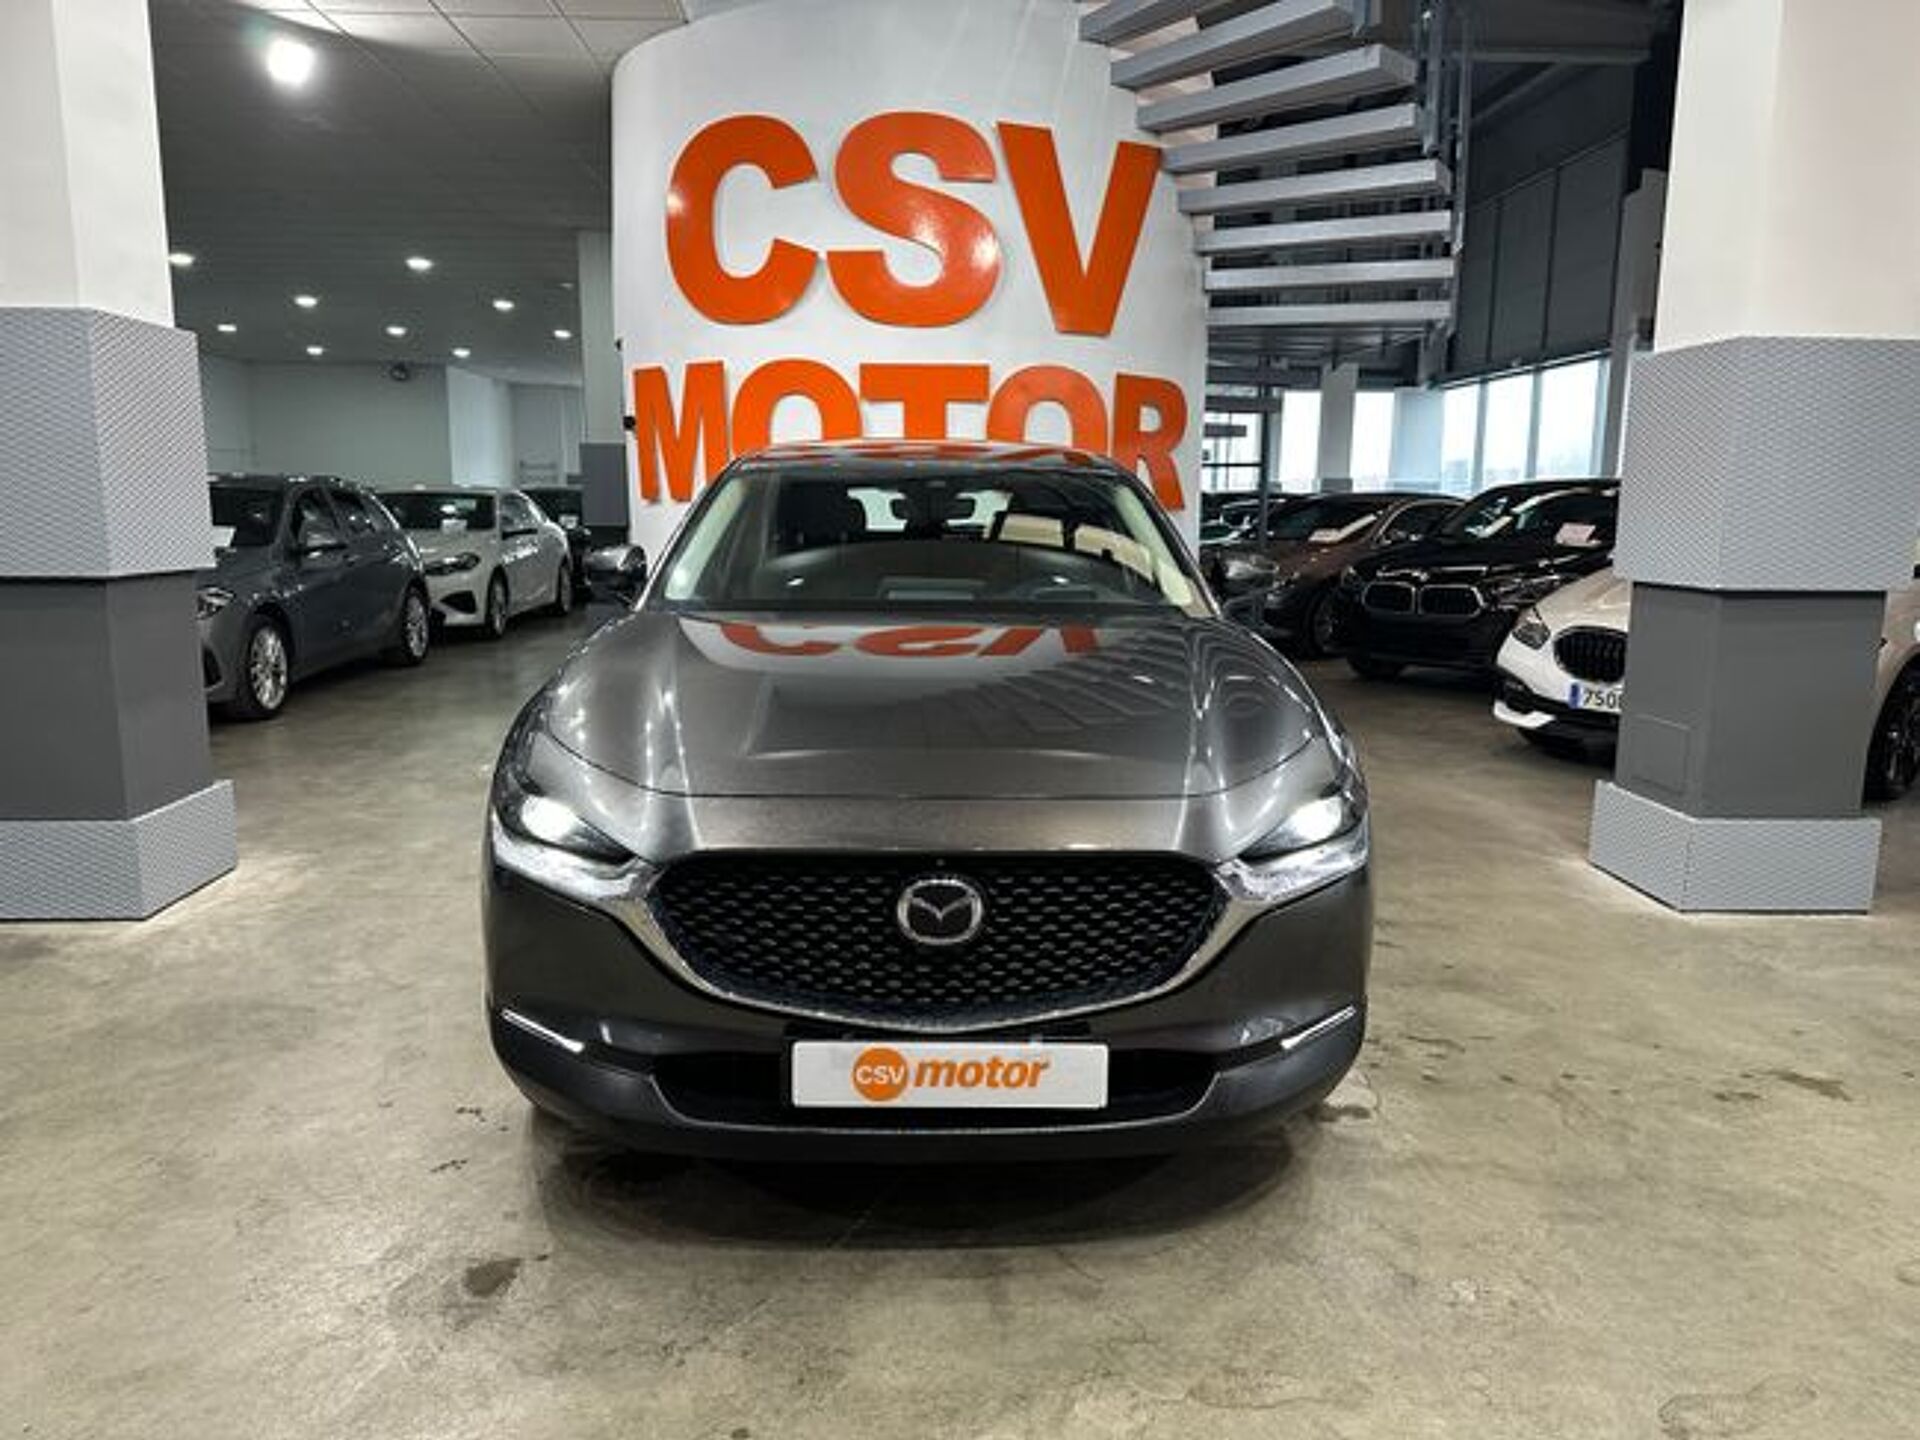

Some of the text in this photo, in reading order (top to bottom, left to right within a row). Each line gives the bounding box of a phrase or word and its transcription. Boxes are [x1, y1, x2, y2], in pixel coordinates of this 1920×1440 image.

[665, 111, 1162, 337] CSV
[1583, 688, 1622, 709] 750
[854, 1055, 1050, 1089] CSV motor
